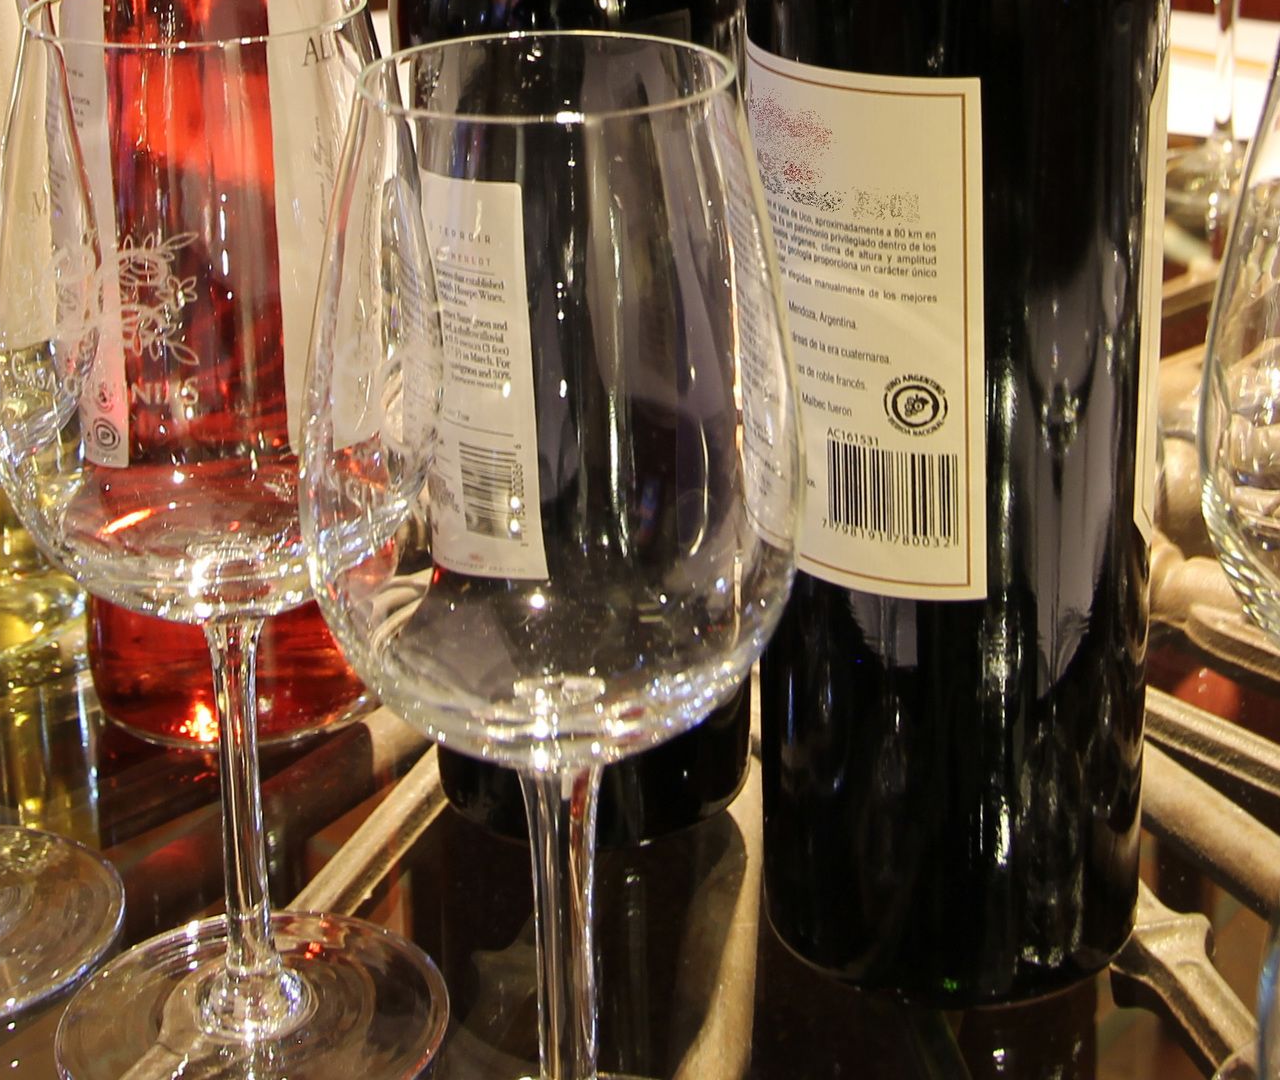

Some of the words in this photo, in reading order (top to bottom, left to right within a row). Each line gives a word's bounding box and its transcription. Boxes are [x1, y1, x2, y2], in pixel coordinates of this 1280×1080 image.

[794, 220, 829, 240] patrimonio
[830, 231, 876, 248] privilegiado
[878, 236, 907, 252] dentro
[908, 240, 921, 252] de
[922, 240, 937, 253] los
[799, 210, 814, 225] Uco,
[815, 215, 884, 237] aproximadamente
[886, 230, 892, 238] a
[893, 228, 906, 239] 80
[908, 228, 923, 239] km
[925, 230, 937, 240] en
[813, 252, 858, 272] proporciona
[860, 262, 871, 273] un
[873, 261, 909, 277] carácter
[911, 264, 938, 279] único
[820, 240, 841, 256] clima
[844, 244, 855, 257] de
[858, 246, 883, 261] altura
[886, 252, 893, 265] y
[896, 252, 938, 267] amplitud
[788, 270, 812, 287] elegidas
[814, 278, 865, 297] manualmente
[868, 289, 880, 300] de
[883, 290, 896, 301] los
[900, 294, 938, 306] mejores
[456, 311, 492, 329] Sauvgnon
[788, 300, 818, 323] Mendoza,
[819, 311, 858, 330] Argentina.
[809, 337, 819, 350] de
[819, 341, 826, 353] la
[827, 345, 840, 357] era
[806, 366, 815, 377] de
[816, 368, 836, 384] roble
[836, 375, 867, 391] francés.
[801, 391, 826, 411] Malbec
[828, 401, 853, 417] fueron
[826, 426, 881, 447] AC161531
